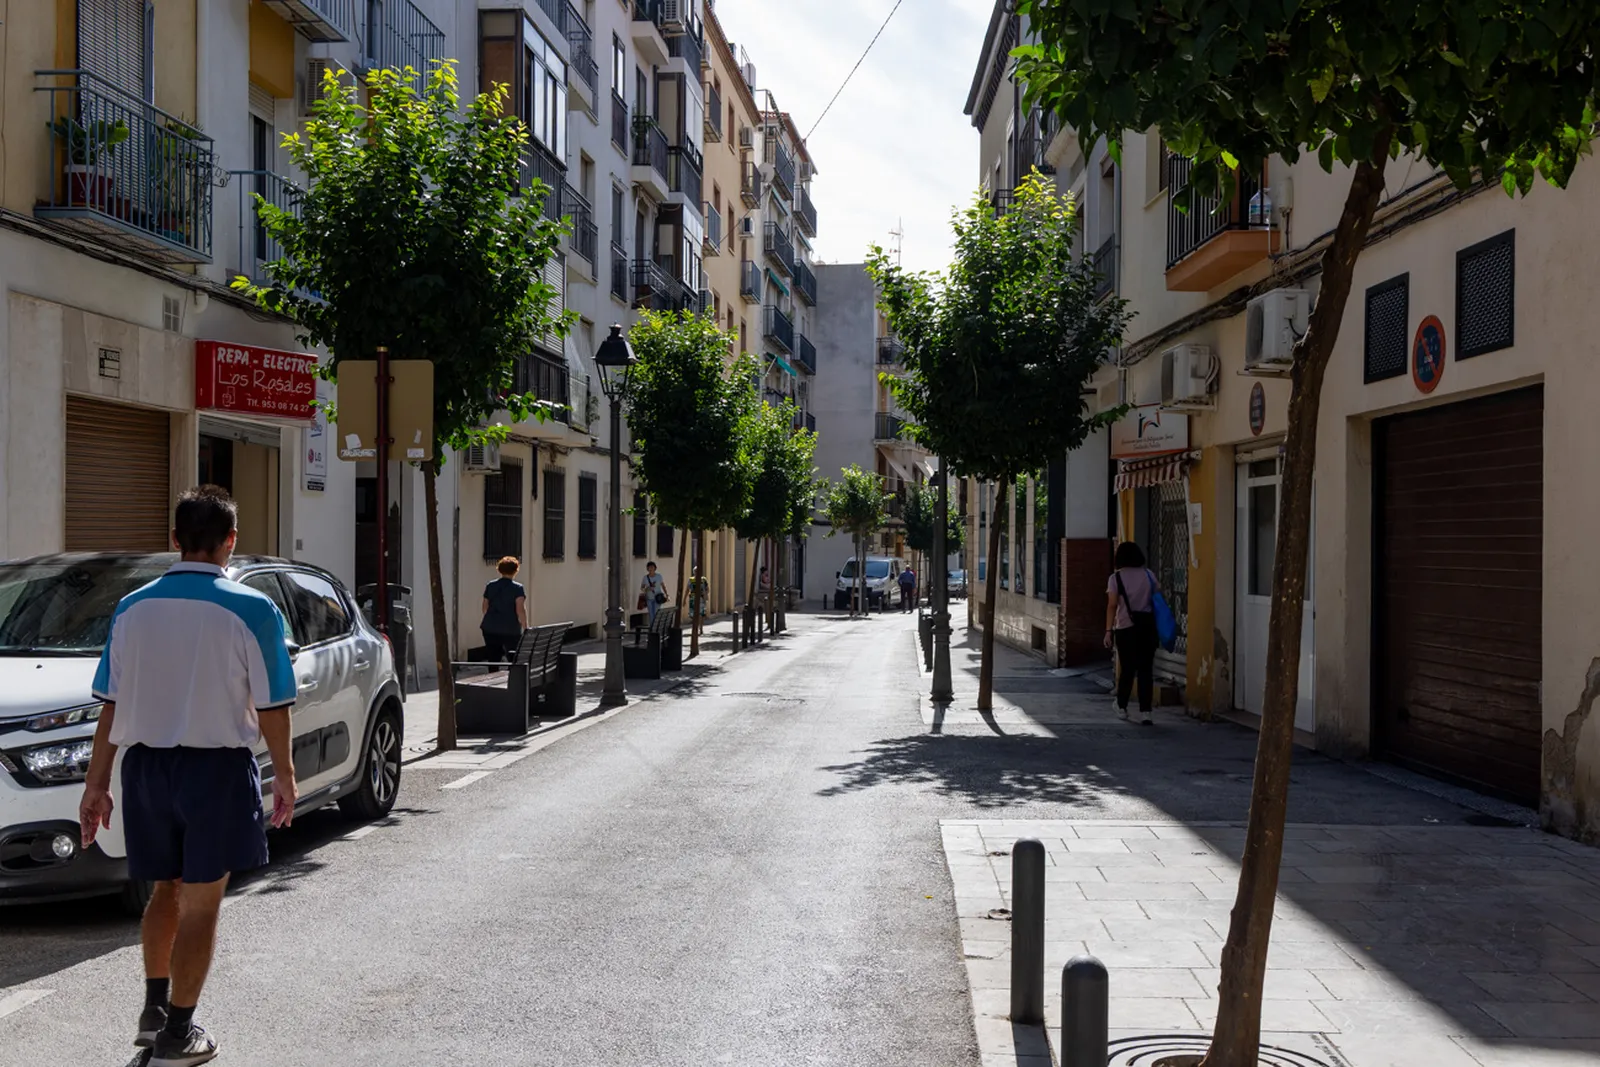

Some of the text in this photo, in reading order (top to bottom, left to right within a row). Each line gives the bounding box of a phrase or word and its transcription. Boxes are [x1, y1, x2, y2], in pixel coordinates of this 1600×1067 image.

[217, 347, 249, 365] REPA
[219, 364, 312, 394] Los Rosales
[262, 399, 276, 410] 953
[289, 403, 299, 412] 74
[301, 404, 310, 413] 27
